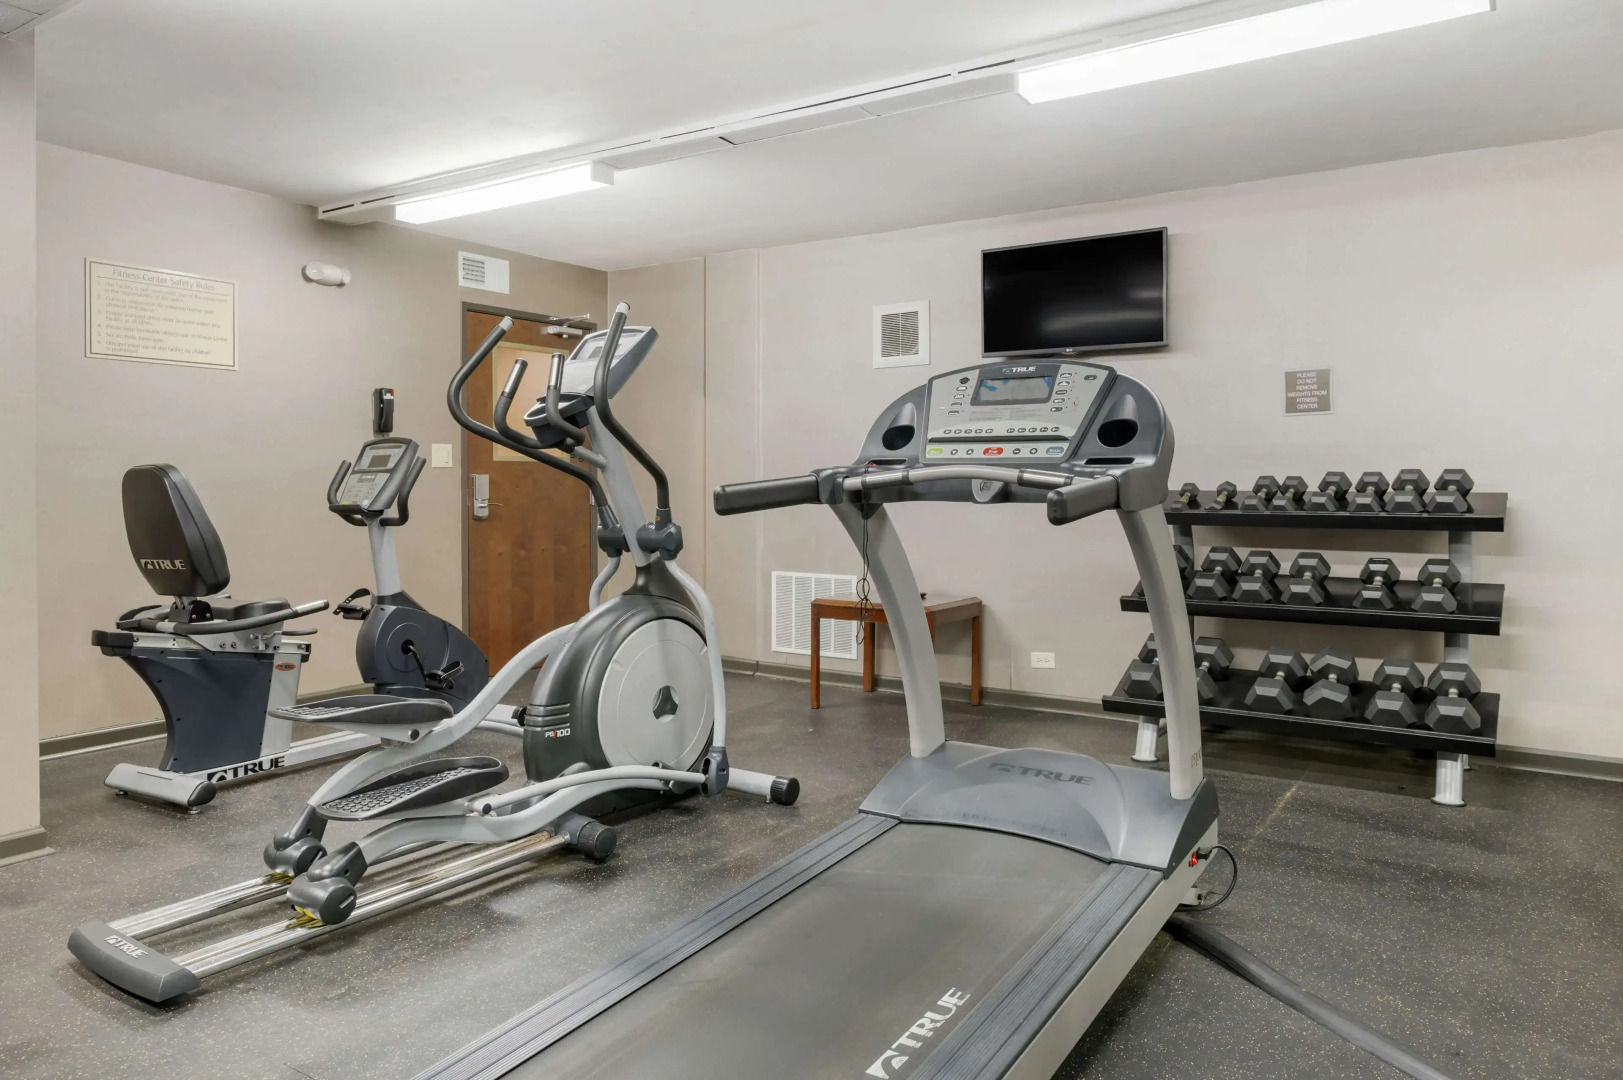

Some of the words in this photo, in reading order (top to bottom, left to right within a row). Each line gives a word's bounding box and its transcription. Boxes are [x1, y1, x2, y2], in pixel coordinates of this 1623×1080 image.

[112, 269, 141, 279] Fitness
[142, 273, 168, 284] Center
[170, 278, 194, 288] Safety
[195, 282, 216, 291] Rules
[150, 559, 187, 570] TRUE
[227, 755, 285, 778] TRUE
[1018, 766, 1094, 786] TRUE
[115, 939, 148, 959] TRUE
[890, 987, 971, 1049] TRUE
